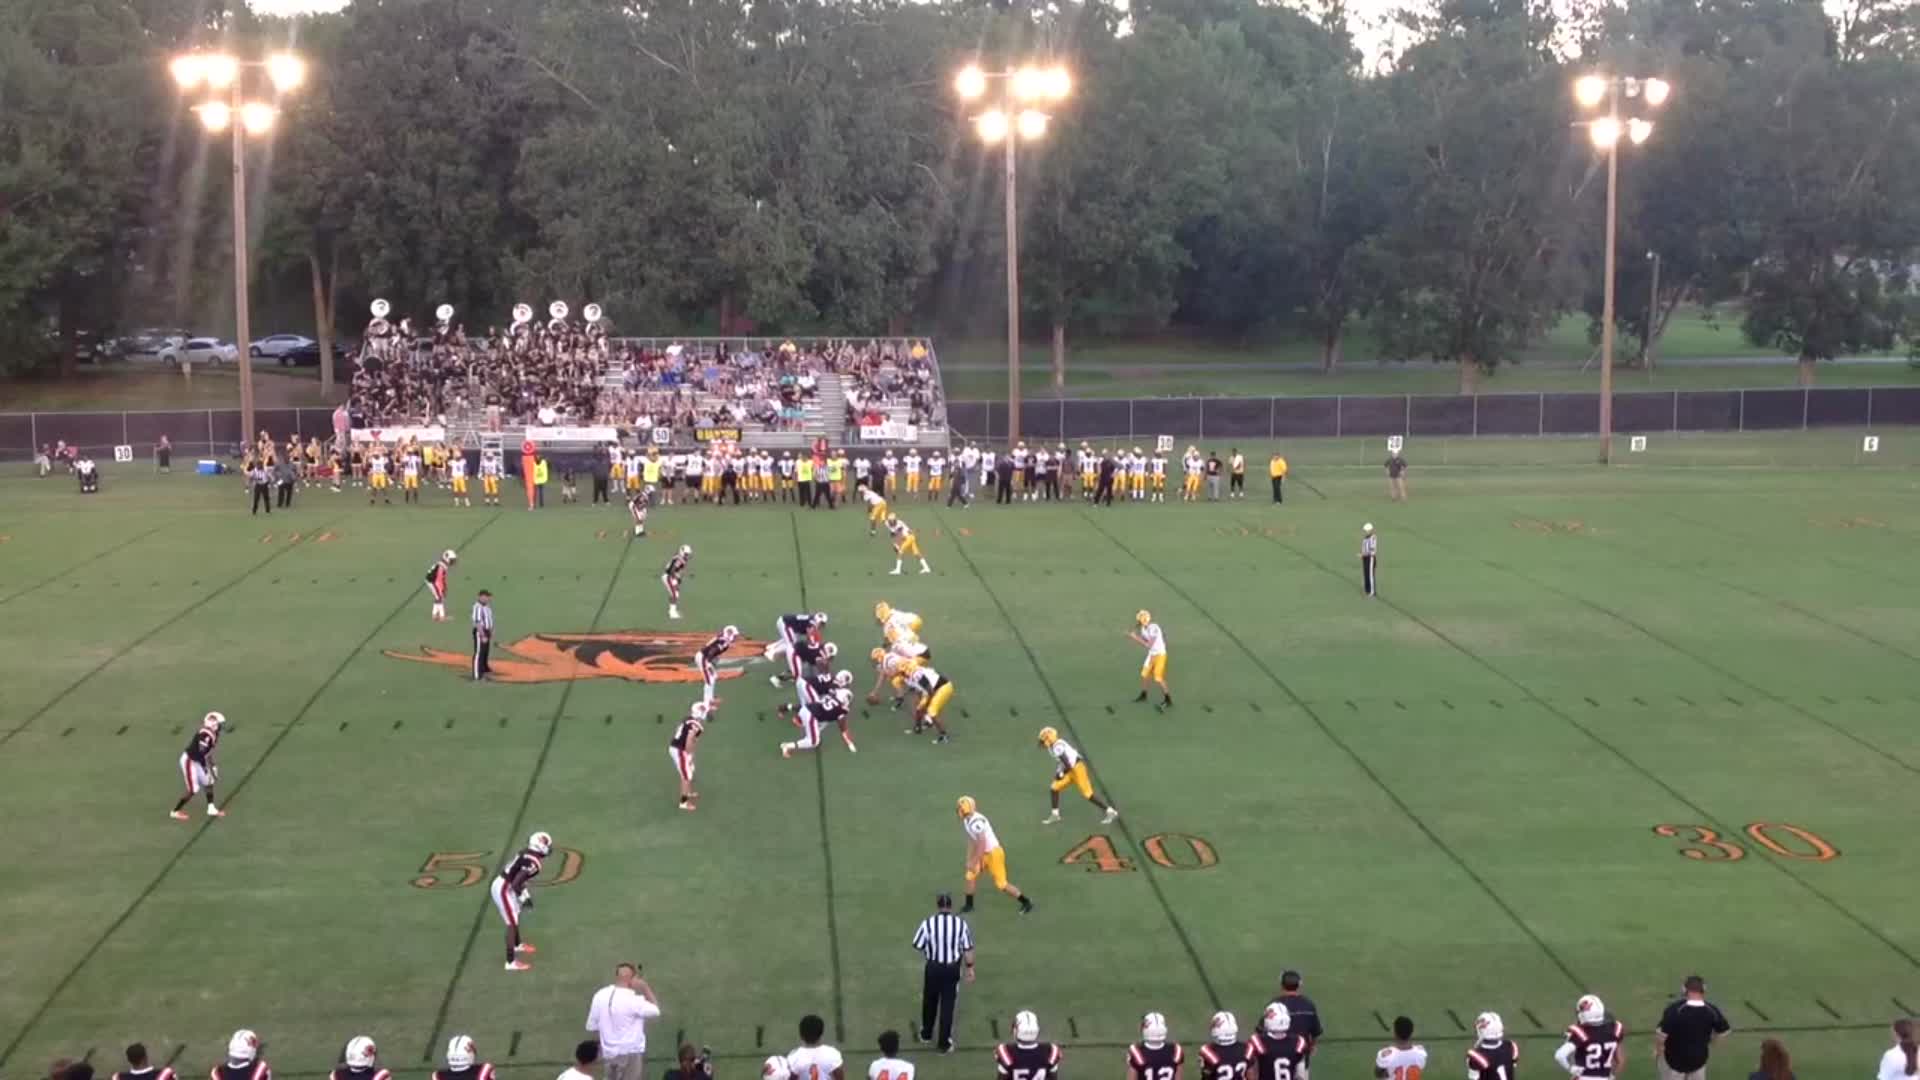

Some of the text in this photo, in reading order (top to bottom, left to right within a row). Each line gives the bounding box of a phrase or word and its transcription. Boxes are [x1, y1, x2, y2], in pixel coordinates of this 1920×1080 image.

[1058, 832, 1221, 873] 40
[1651, 822, 1842, 864] 30
[1274, 1057, 1291, 1080] 6
[1585, 1041, 1618, 1070] 27
